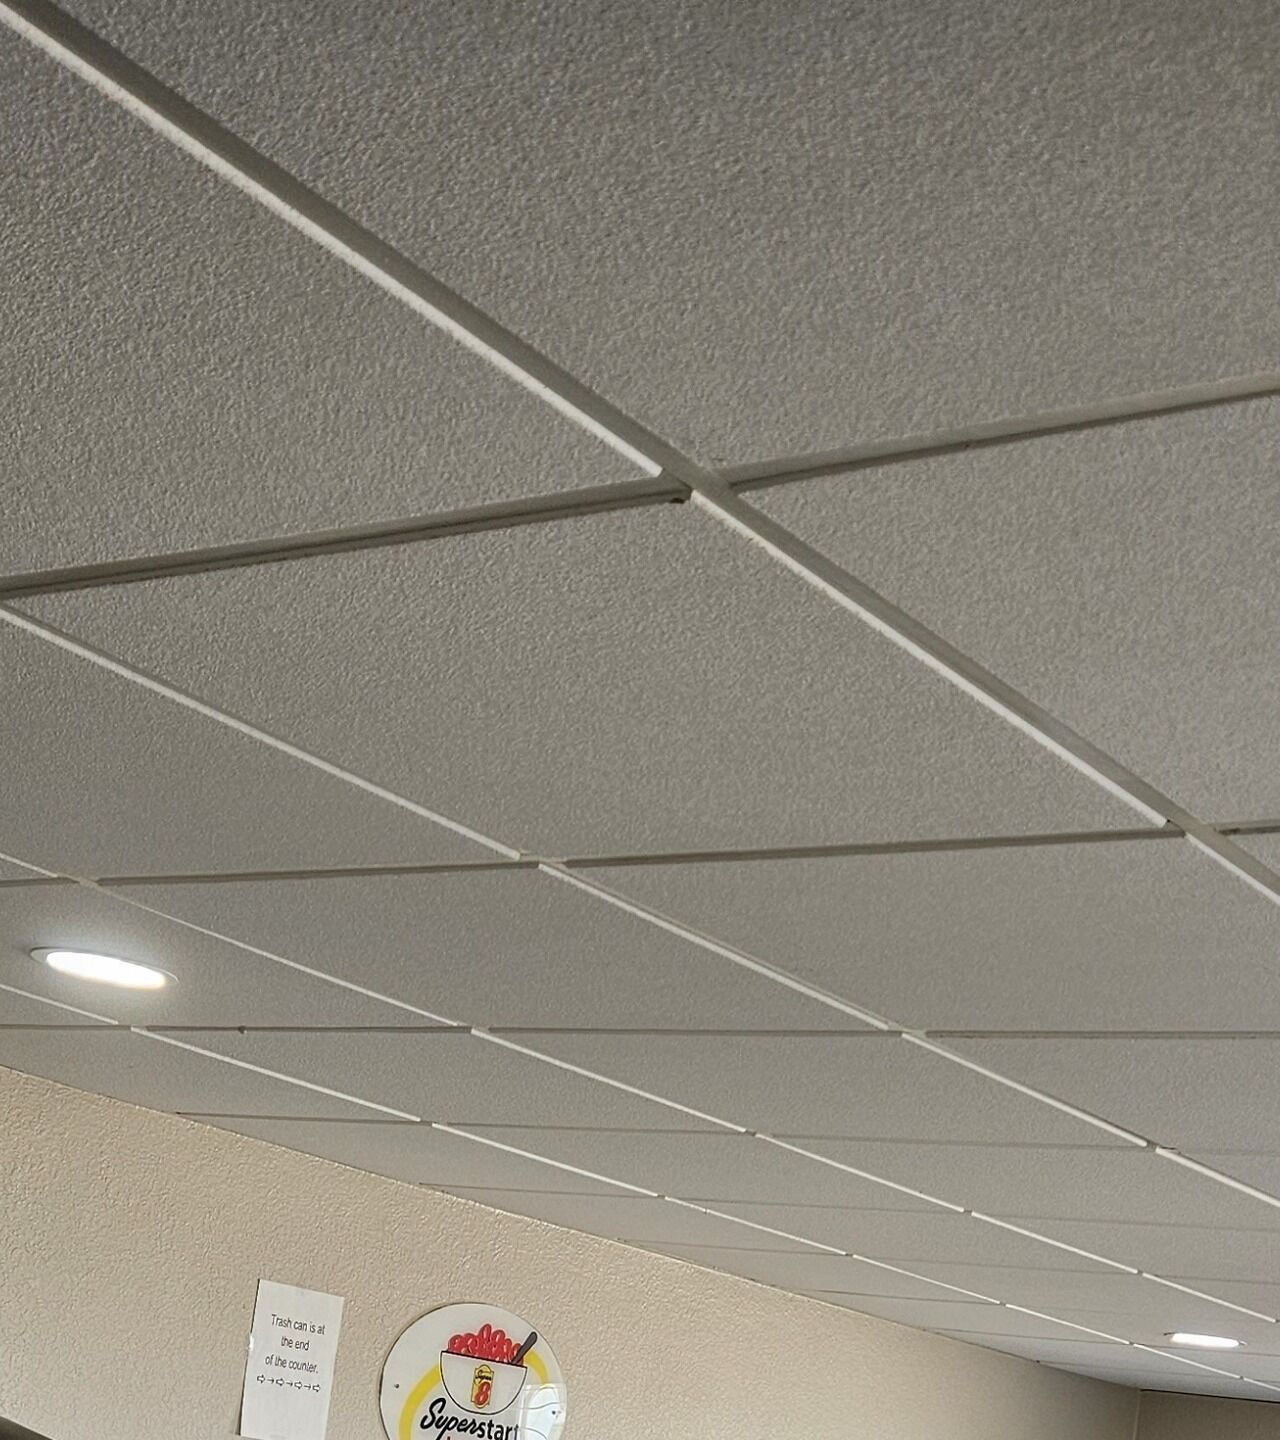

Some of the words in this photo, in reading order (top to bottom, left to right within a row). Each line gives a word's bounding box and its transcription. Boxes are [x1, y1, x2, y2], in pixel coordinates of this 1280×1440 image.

[271, 1313, 292, 1329] Trash
[293, 1320, 308, 1332] can
[309, 1321, 316, 1333] is
[317, 1325, 326, 1335] at
[281, 1336, 293, 1349] the
[295, 1340, 310, 1351] end
[265, 1354, 274, 1366] of
[274, 1355, 287, 1368] the
[288, 1360, 319, 1374] counter.
[474, 1381, 491, 1406] 8
